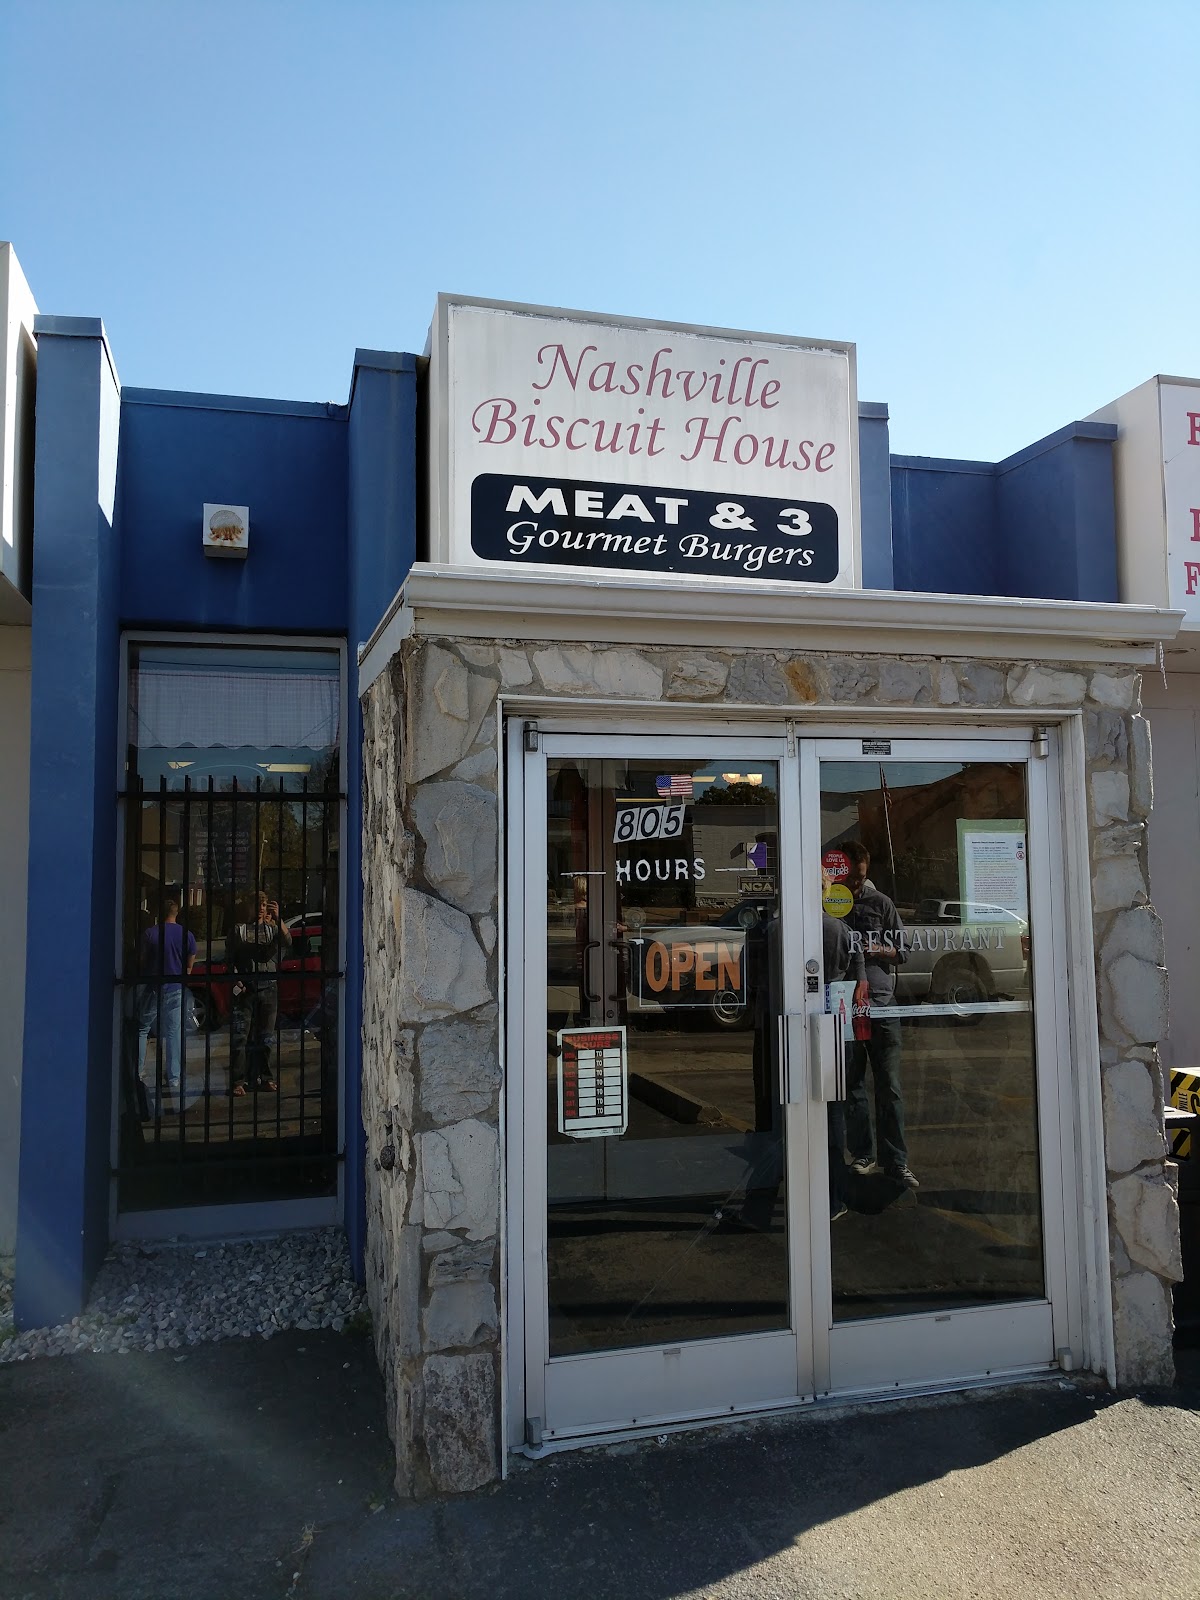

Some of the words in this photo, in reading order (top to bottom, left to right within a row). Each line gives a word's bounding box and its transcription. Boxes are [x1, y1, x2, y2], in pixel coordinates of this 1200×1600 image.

[531, 344, 781, 409] Nashville
[472, 398, 666, 457] Biscuit
[680, 415, 836, 473] House
[505, 485, 689, 525] MEAT
[709, 501, 758, 532] &
[777, 507, 813, 536] 3
[506, 520, 668, 555] Gourmet
[678, 533, 815, 572] Burgers
[617, 806, 683, 841] 805
[616, 858, 706, 882] HOURS
[848, 927, 1007, 953] RESTAURANT
[645, 941, 744, 992] OPEN
[563, 1033, 619, 1042] BUSINESS
[574, 1040, 611, 1049] HOURS
